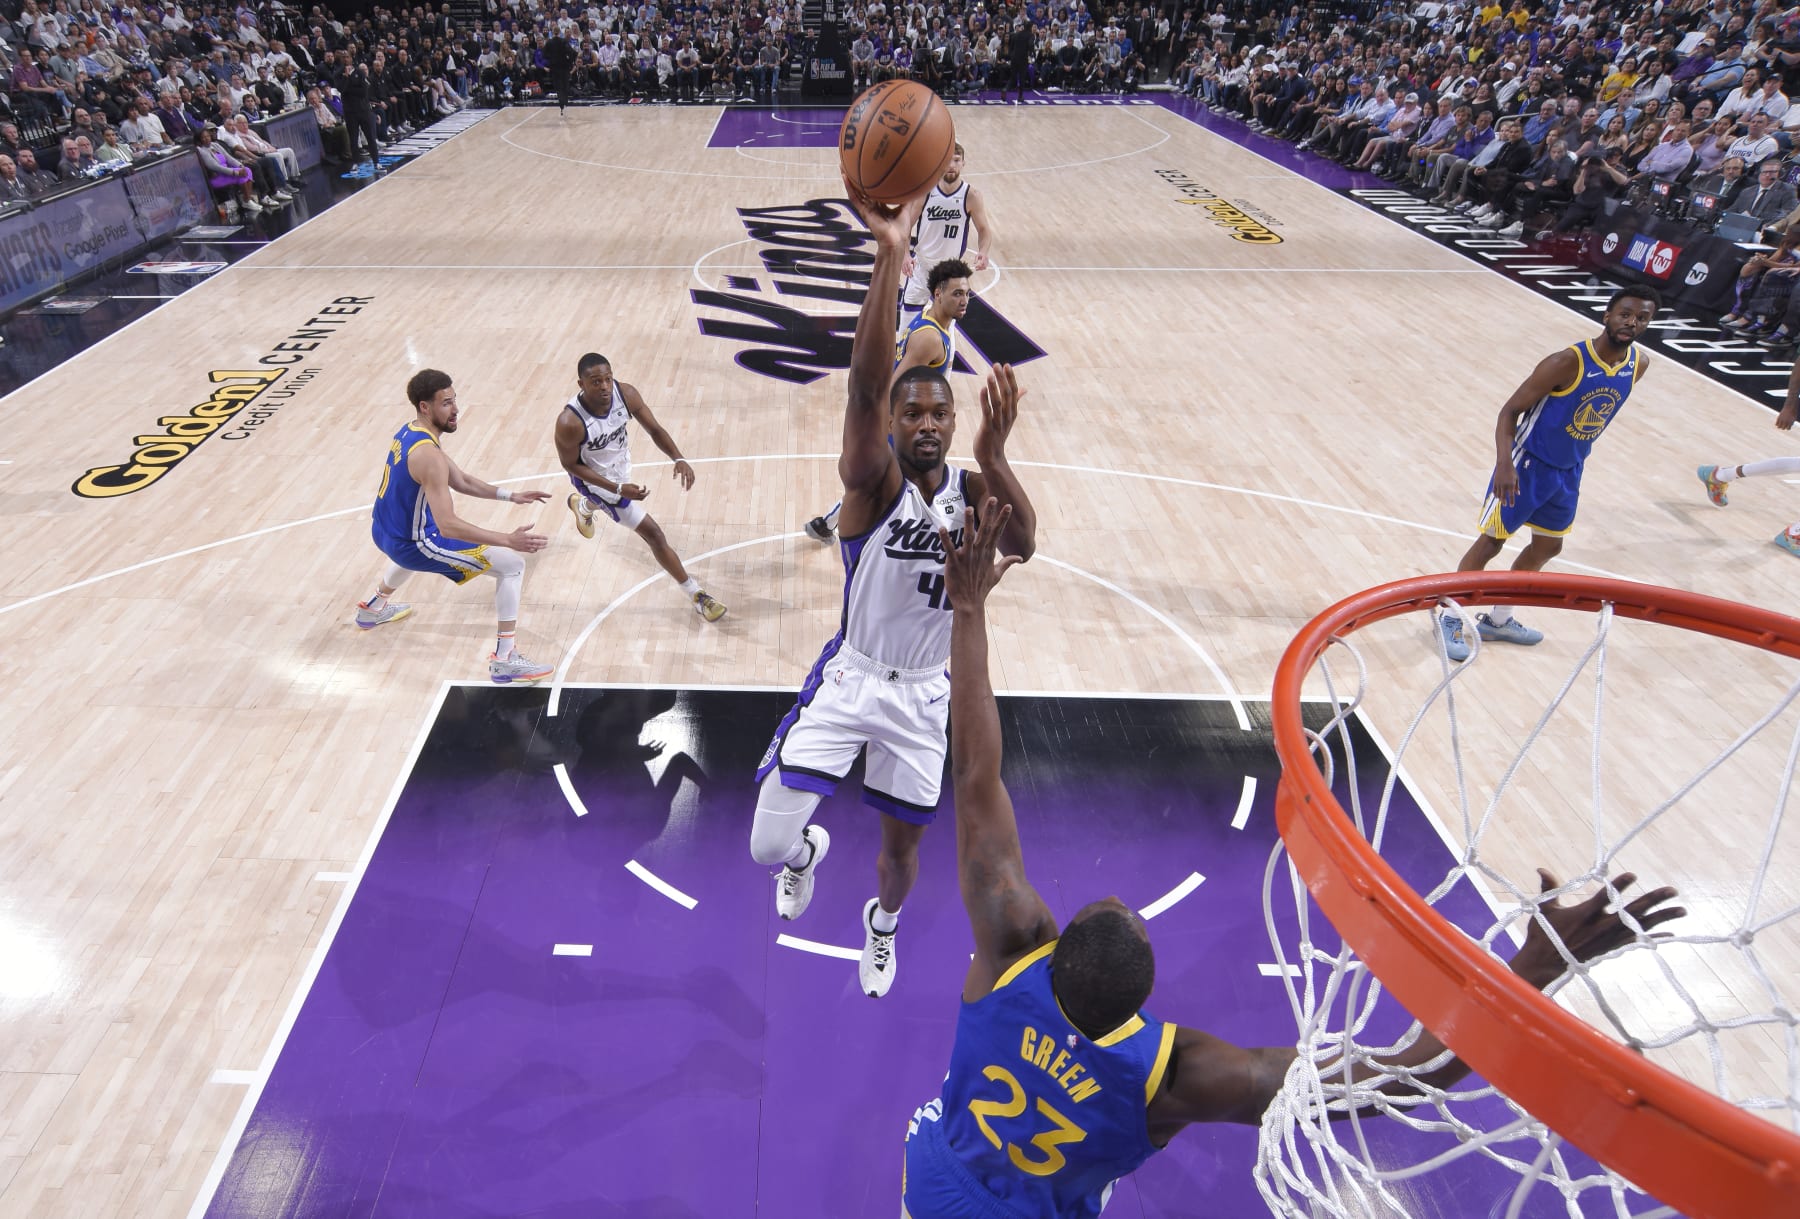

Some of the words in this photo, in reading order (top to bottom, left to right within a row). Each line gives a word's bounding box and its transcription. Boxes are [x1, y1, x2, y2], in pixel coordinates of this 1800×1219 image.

[1154, 169, 1218, 199] CENTER
[926, 205, 962, 222] Kings
[943, 223, 960, 239] 10
[64, 231, 105, 261] Google
[104, 221, 128, 241] Pixel
[1627, 240, 1649, 263] NBA
[258, 296, 376, 366] CENTER
[220, 400, 285, 441] Credit
[273, 367, 323, 400] Union
[1581, 386, 1610, 402] GOLDEN
[1599, 402, 1614, 415] 22
[917, 571, 954, 611] 4
[1020, 1026, 1103, 1104] GREEN
[968, 1064, 1089, 1177] 23
